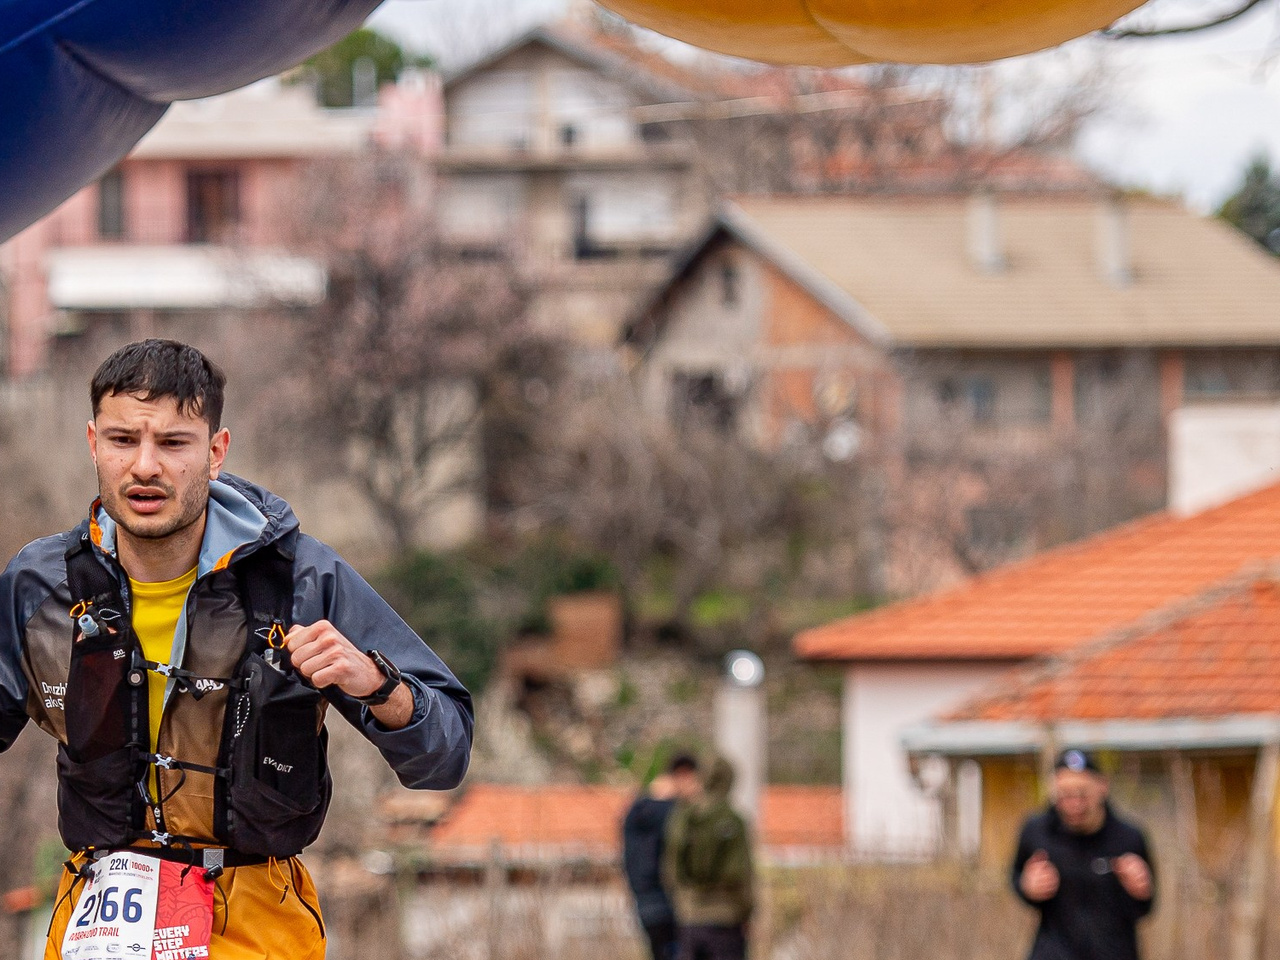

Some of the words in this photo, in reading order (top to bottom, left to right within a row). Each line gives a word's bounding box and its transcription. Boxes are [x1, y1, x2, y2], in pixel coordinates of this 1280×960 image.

[109, 858, 128, 870] 22K
[76, 886, 142, 928] 2166
[99, 926, 120, 937] TRAIL
[153, 925, 190, 940] EVERY
[153, 938, 183, 951] STEP
